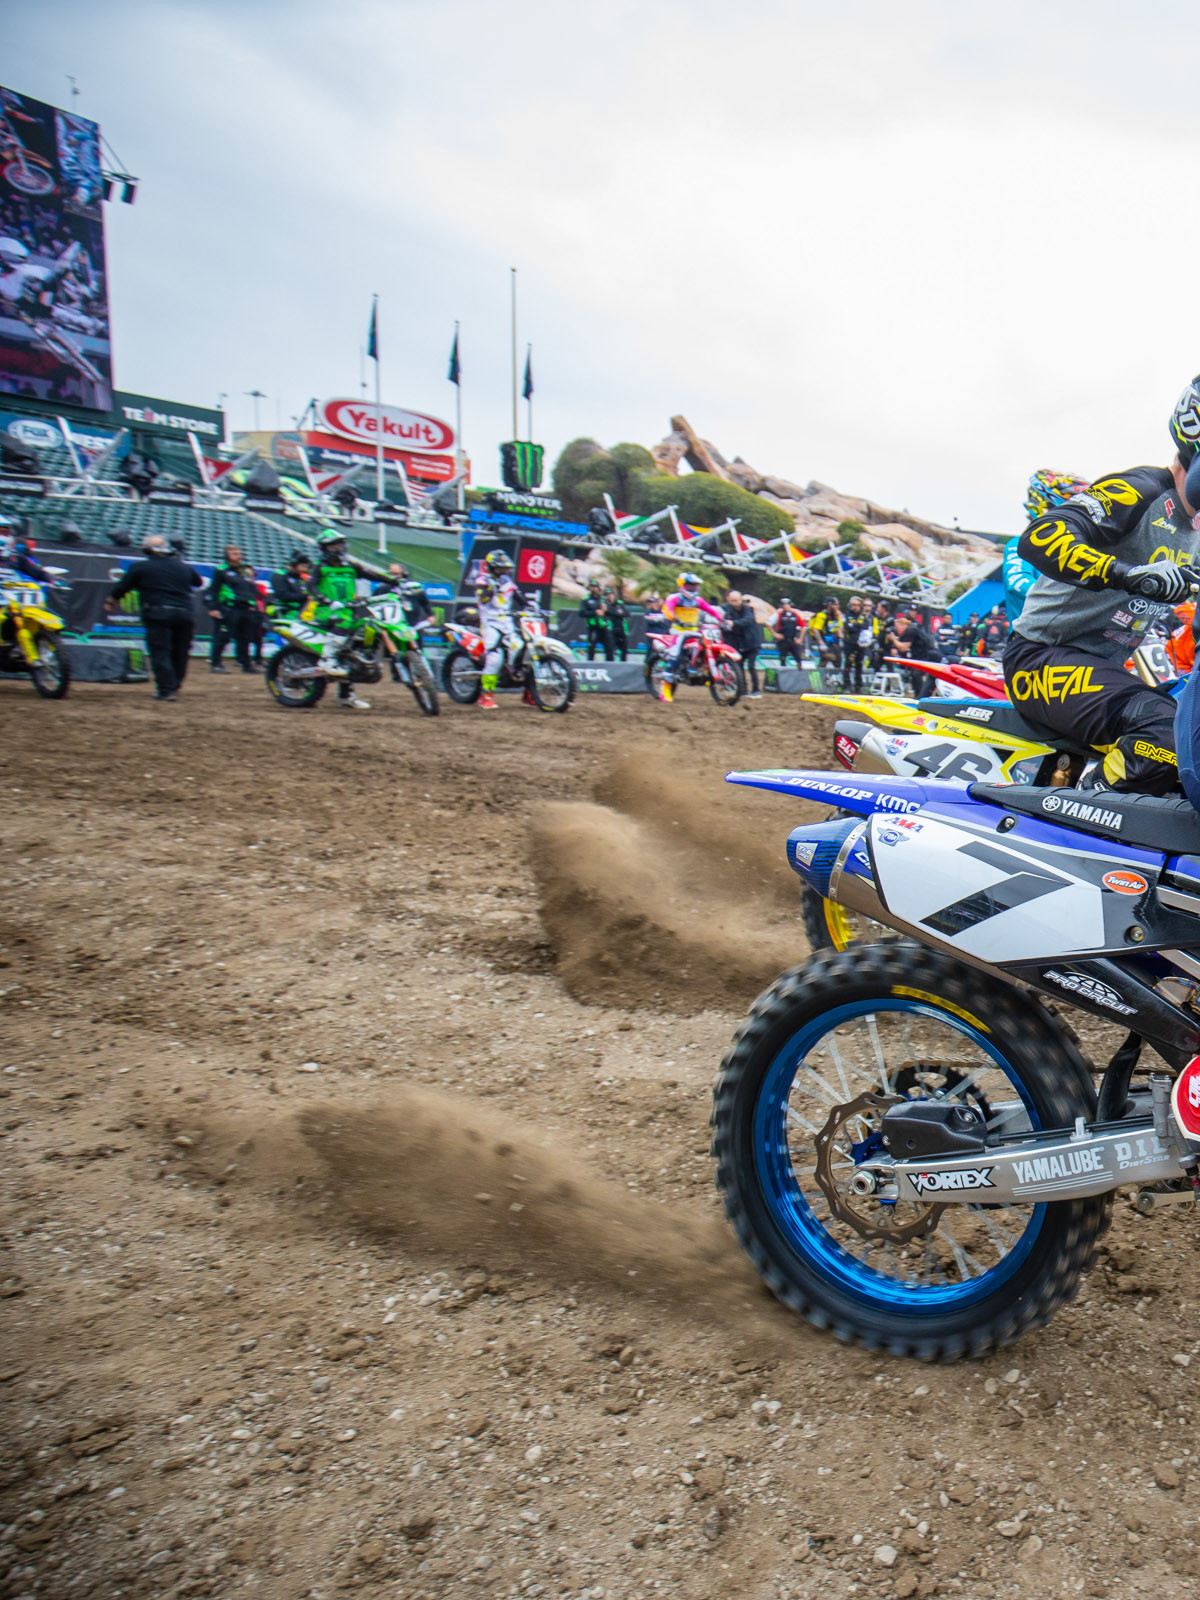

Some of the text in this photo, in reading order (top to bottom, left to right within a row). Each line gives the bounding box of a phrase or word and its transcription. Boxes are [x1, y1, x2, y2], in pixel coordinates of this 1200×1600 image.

[169, 413, 218, 436] STORE
[346, 408, 437, 443] Yakult
[959, 707, 994, 722] JGR
[904, 743, 993, 782] 46
[785, 777, 874, 800] DUNLOP
[883, 816, 924, 833] AMA
[1060, 798, 1124, 831] YAMAHA
[919, 840, 1075, 937] 7
[1107, 875, 1145, 890] Twin Air
[1043, 970, 1139, 1016] PRO CIRCUIT
[906, 1166, 998, 1196] VORTEX
[1011, 1147, 1104, 1184] YAMALUBE
